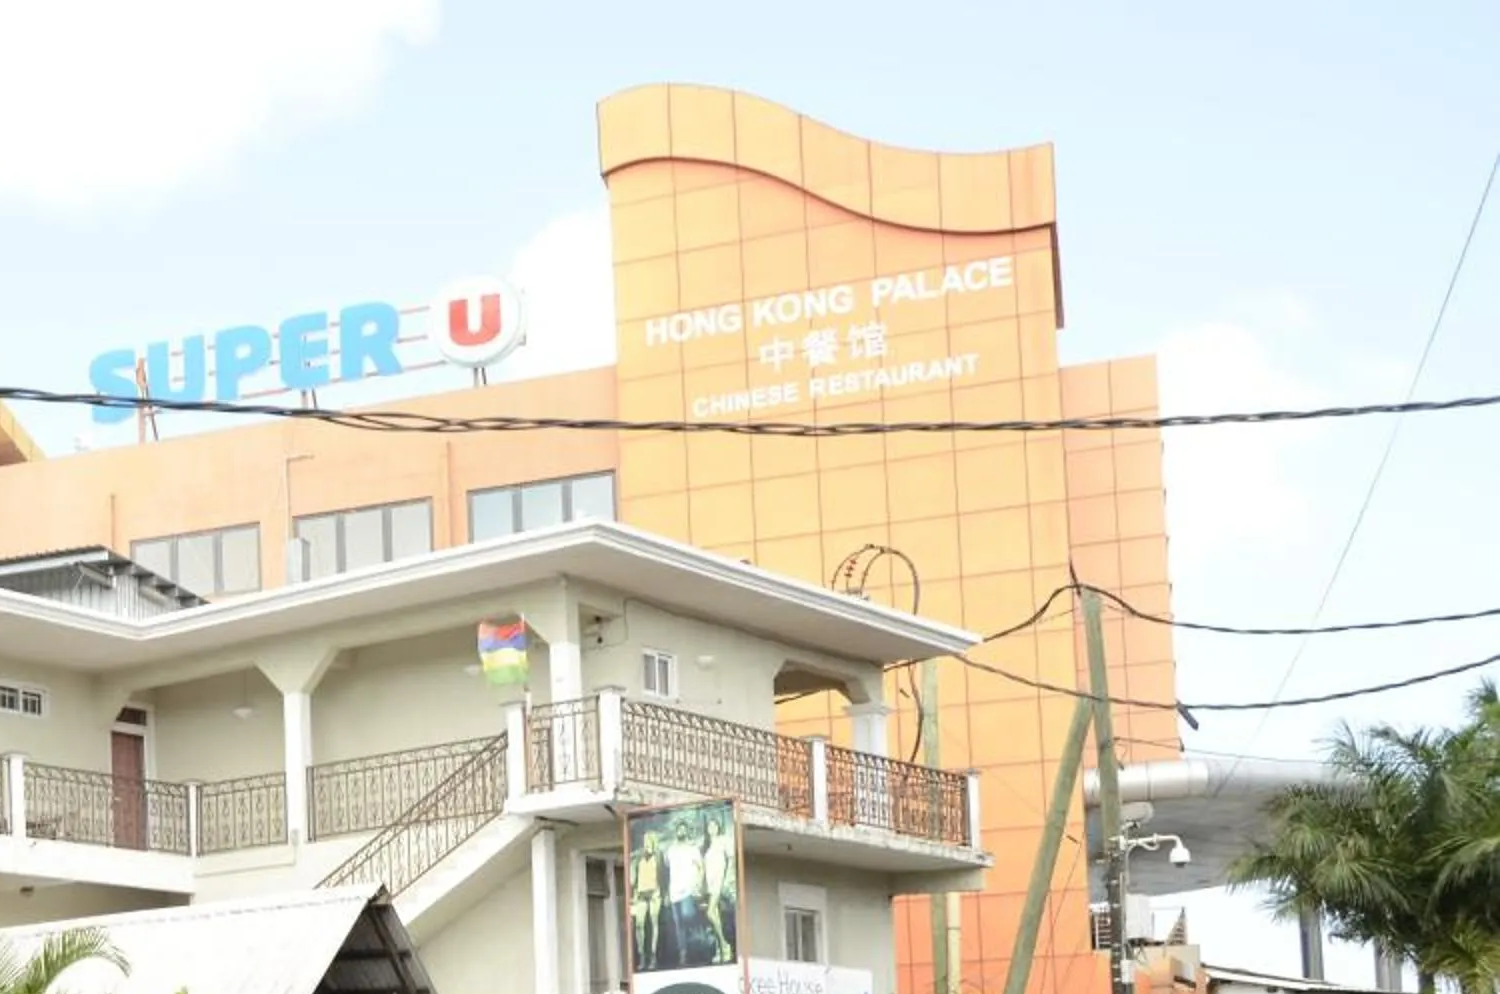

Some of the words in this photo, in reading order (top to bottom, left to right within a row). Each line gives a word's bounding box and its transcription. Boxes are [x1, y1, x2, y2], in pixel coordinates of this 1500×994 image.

[645, 304, 742, 347] HONG
[752, 285, 854, 328] KONG
[871, 257, 1014, 307] PALACE
[89, 301, 403, 424] SUPER
[449, 293, 502, 346] U
[693, 381, 799, 419] CHINESE
[809, 353, 980, 398] RESTAURANT
